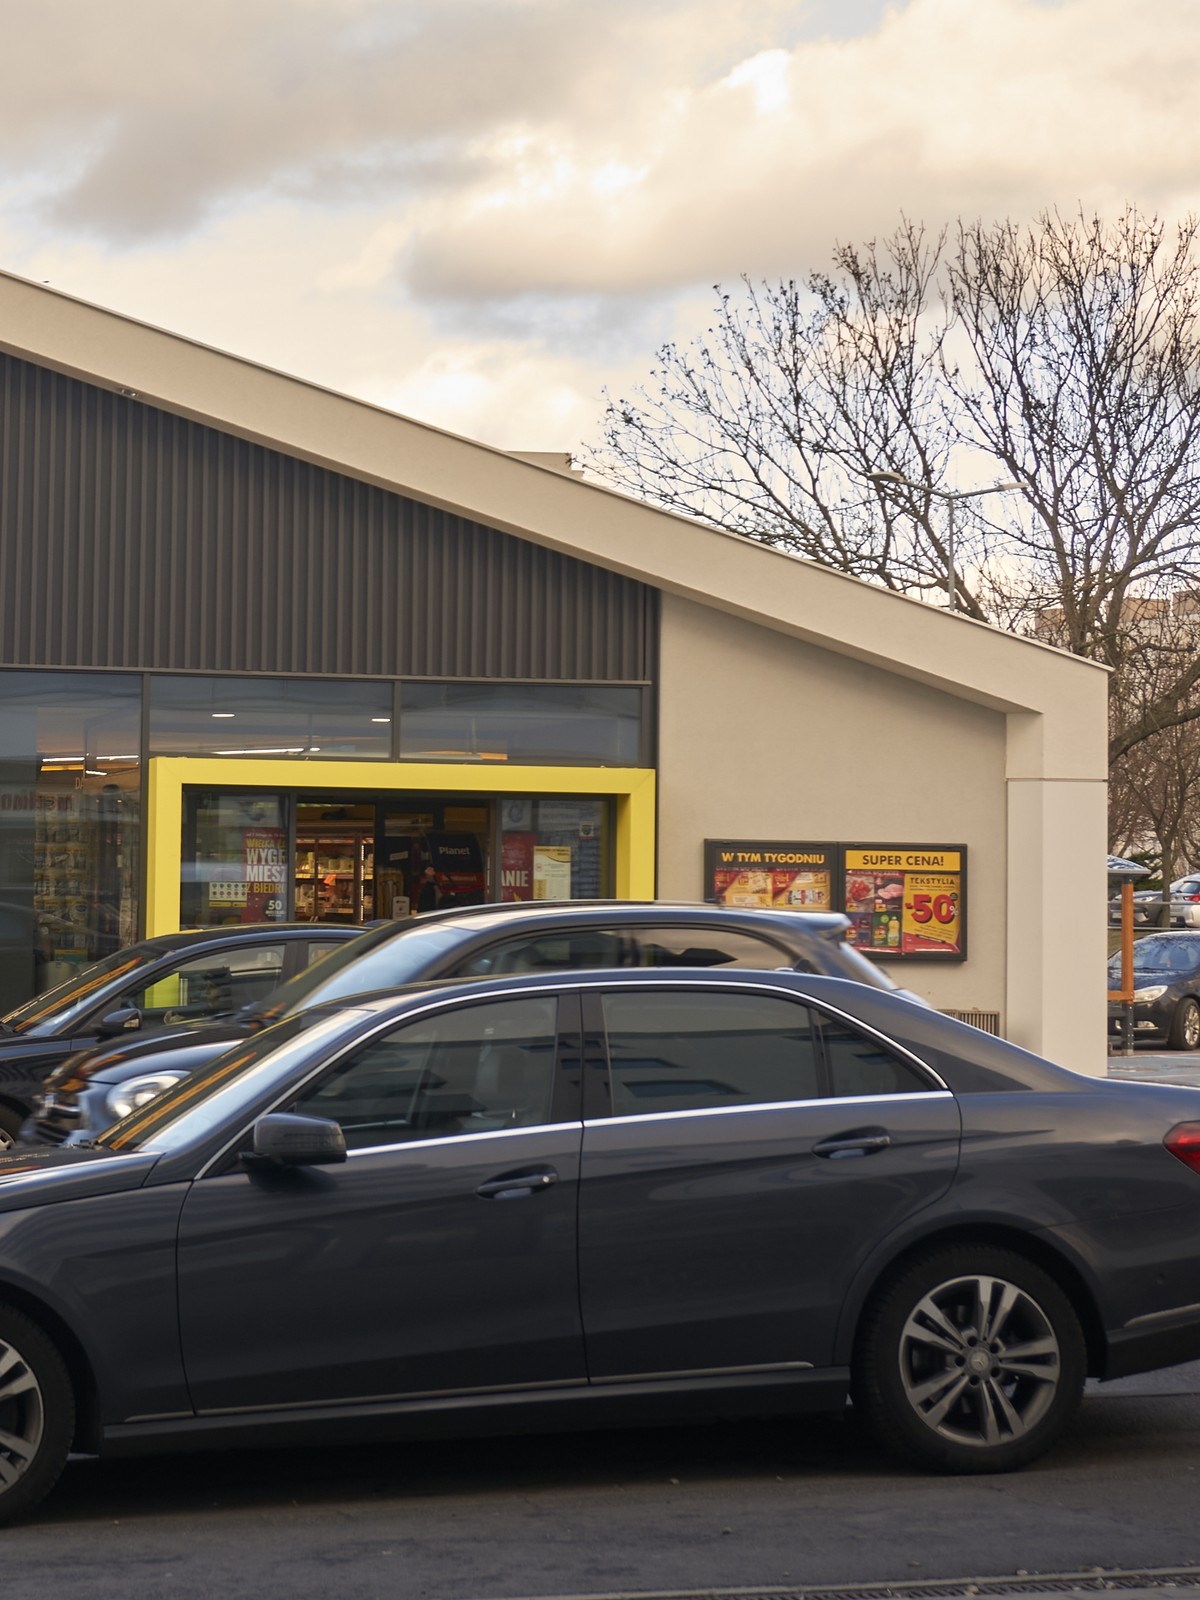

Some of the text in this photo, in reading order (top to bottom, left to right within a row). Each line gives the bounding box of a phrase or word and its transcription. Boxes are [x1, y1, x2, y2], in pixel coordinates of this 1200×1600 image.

[438, 846, 472, 856] Planet
[721, 852, 825, 864] W TYM TYGODNIU
[862, 854, 945, 867] SUPER CENA!
[909, 877, 955, 885] TEKSTYLIA
[268, 900, 282, 910] 50
